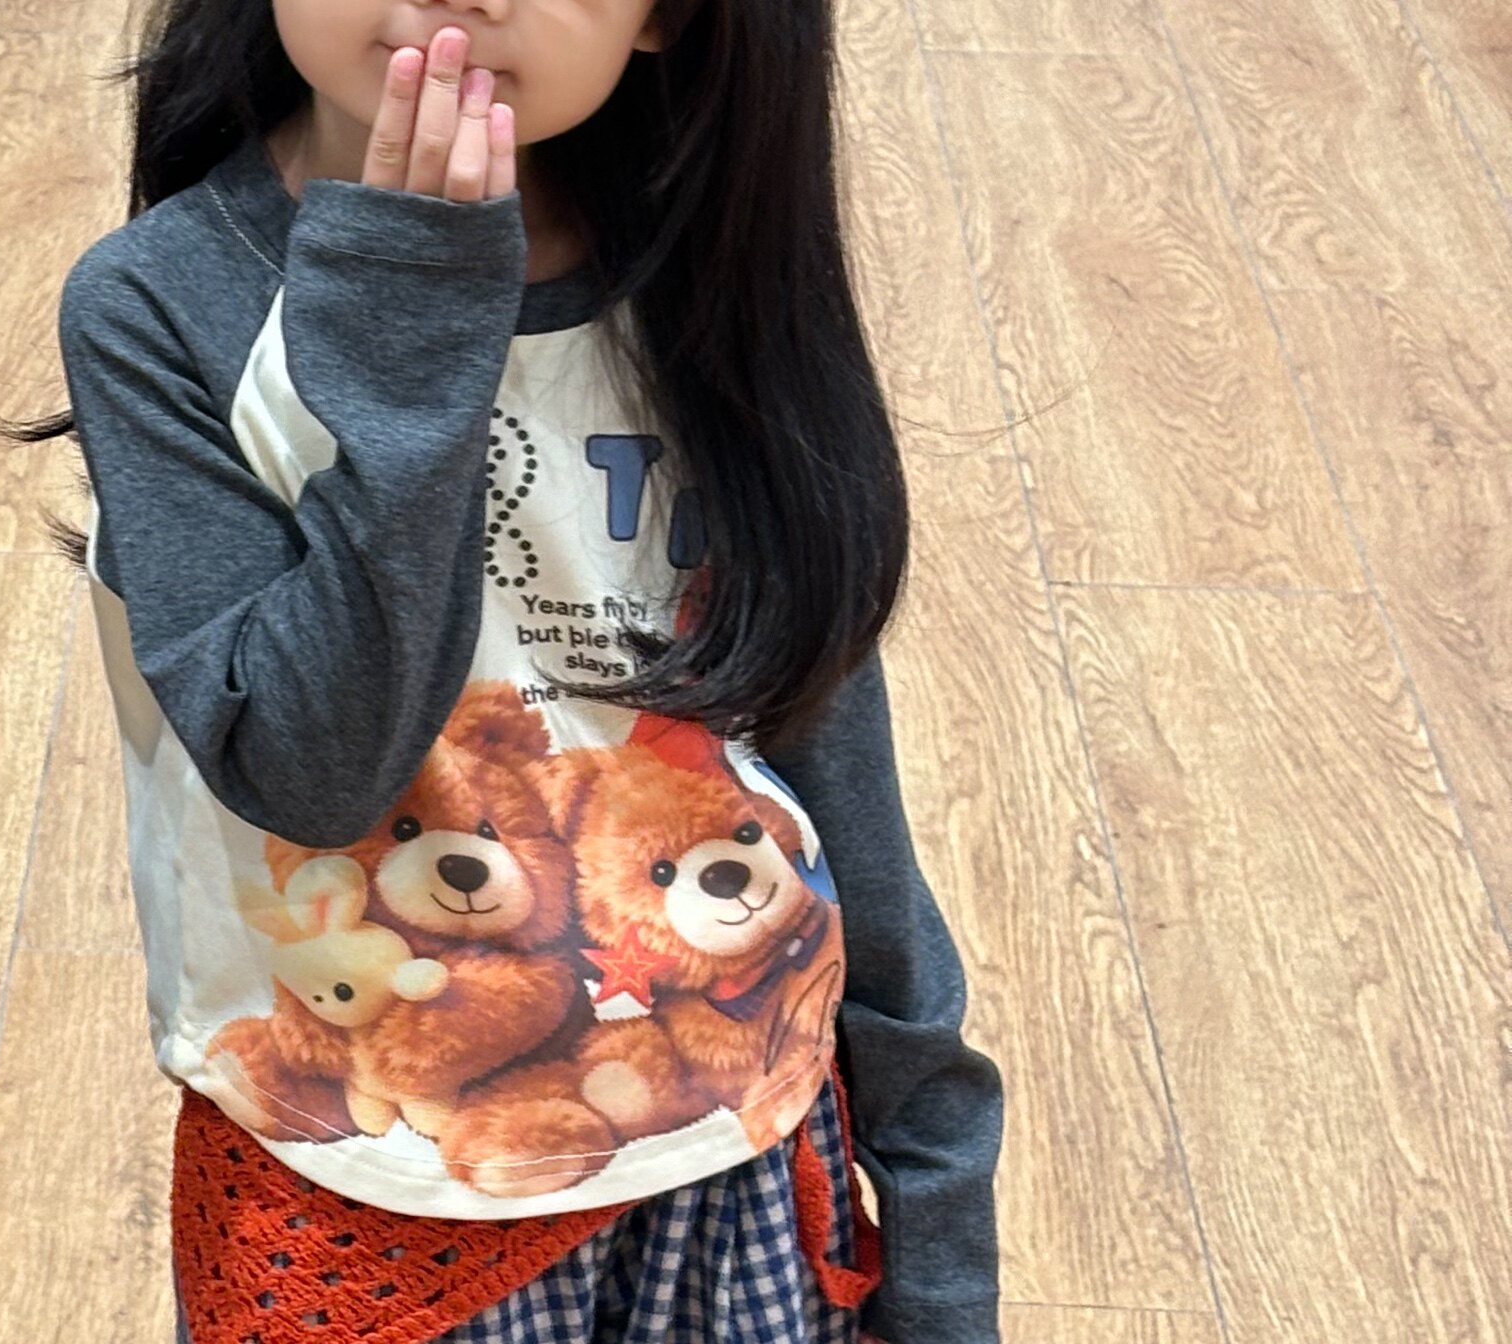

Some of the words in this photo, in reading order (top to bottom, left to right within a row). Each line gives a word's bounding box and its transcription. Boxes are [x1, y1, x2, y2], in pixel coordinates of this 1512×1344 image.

[520, 594, 596, 619] Years
[517, 625, 563, 645] but
[521, 684, 559, 705] the
